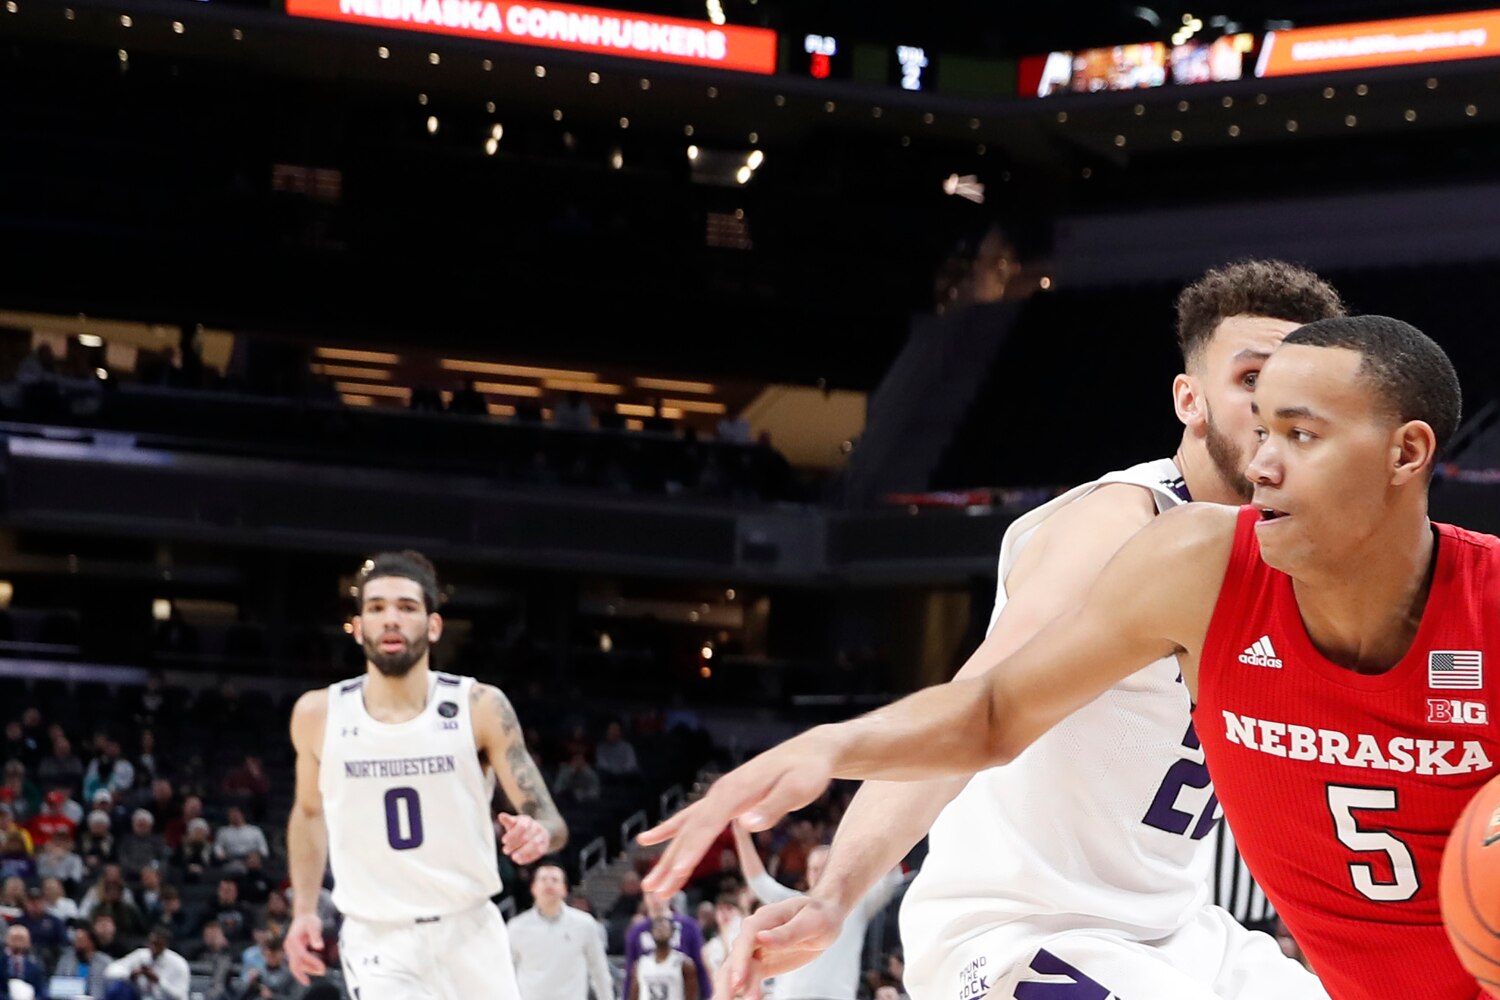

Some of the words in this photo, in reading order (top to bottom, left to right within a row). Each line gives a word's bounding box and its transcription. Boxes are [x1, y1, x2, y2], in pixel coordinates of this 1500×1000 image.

[506, 11, 728, 61] CORNHUSKERS
[1238, 652, 1283, 669] adidas
[344, 755, 456, 778] NORTHWESTERN
[1221, 709, 1494, 776] NEBRASKA
[384, 786, 424, 851] 0
[1326, 782, 1421, 902] 5
